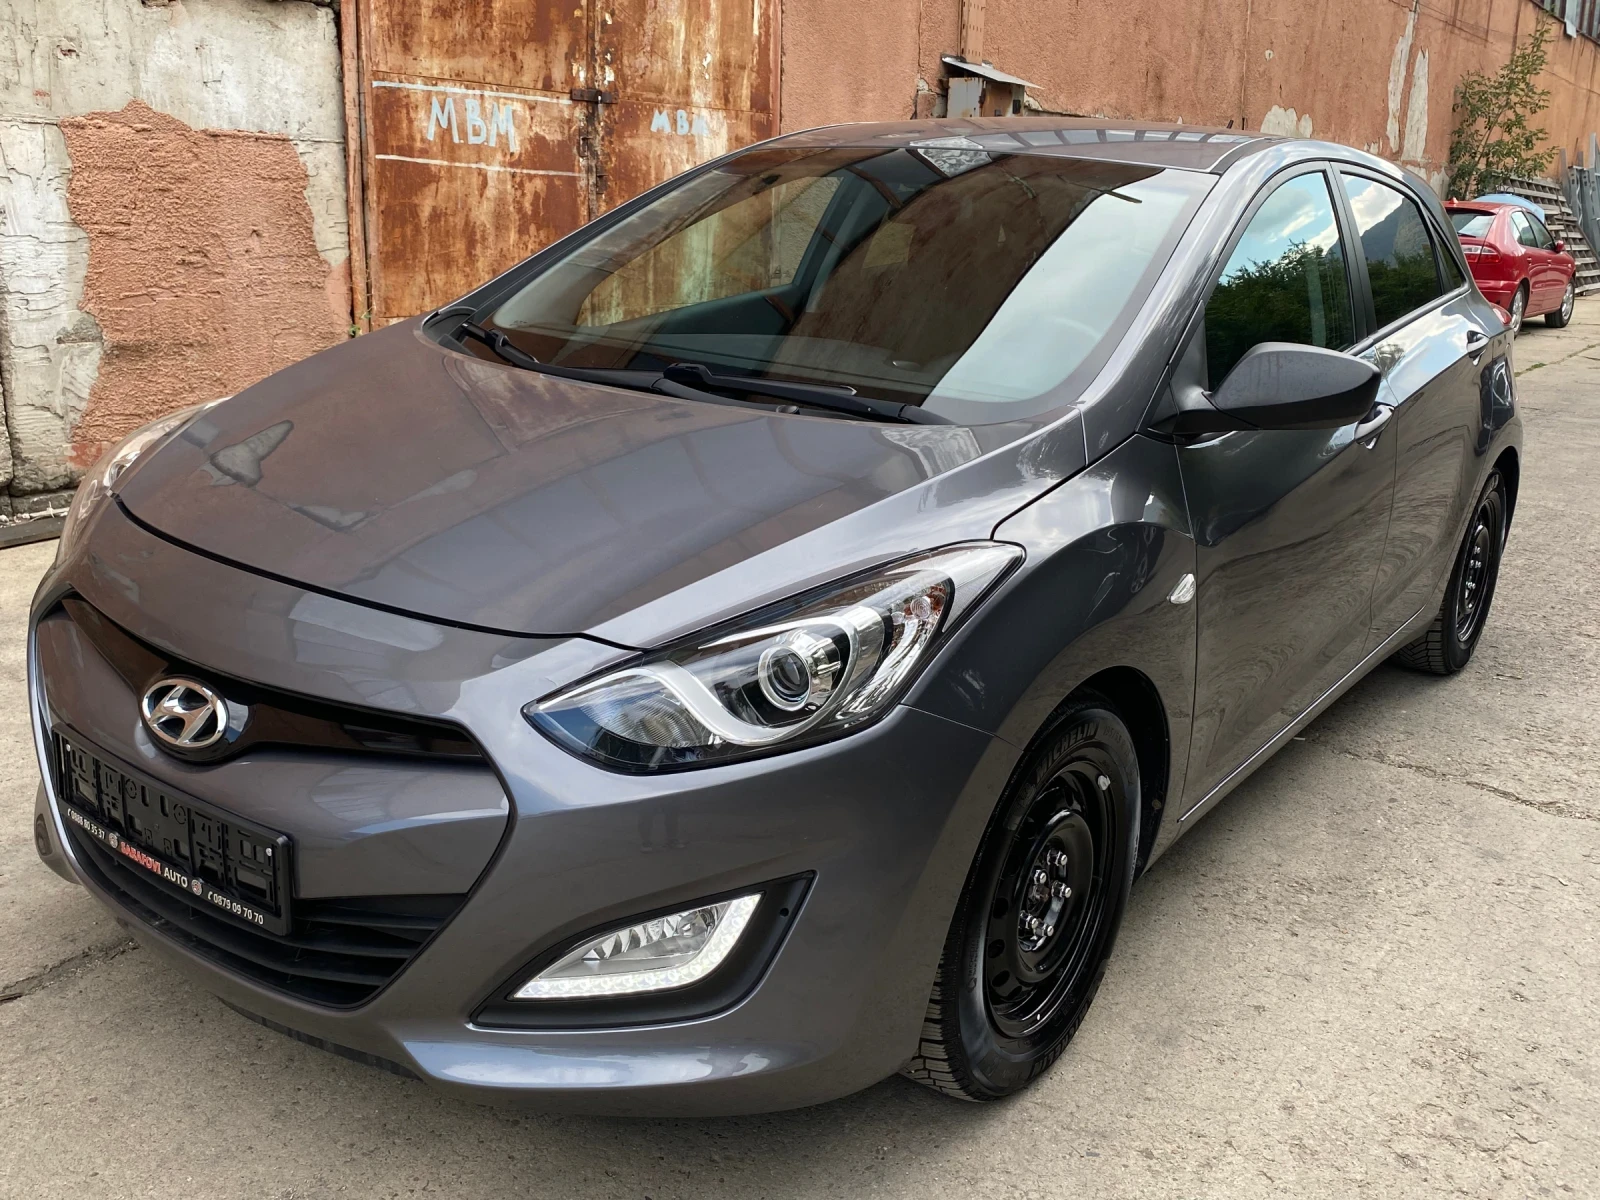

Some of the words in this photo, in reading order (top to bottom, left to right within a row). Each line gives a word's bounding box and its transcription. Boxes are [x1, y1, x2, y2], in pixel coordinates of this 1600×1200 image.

[1037, 720, 1099, 778] MICHELIN
[164, 867, 188, 888] AUTO
[213, 893, 231, 910] 0879
[232, 902, 241, 915] 09
[243, 907, 253, 920] 70
[254, 912, 264, 925] 70
